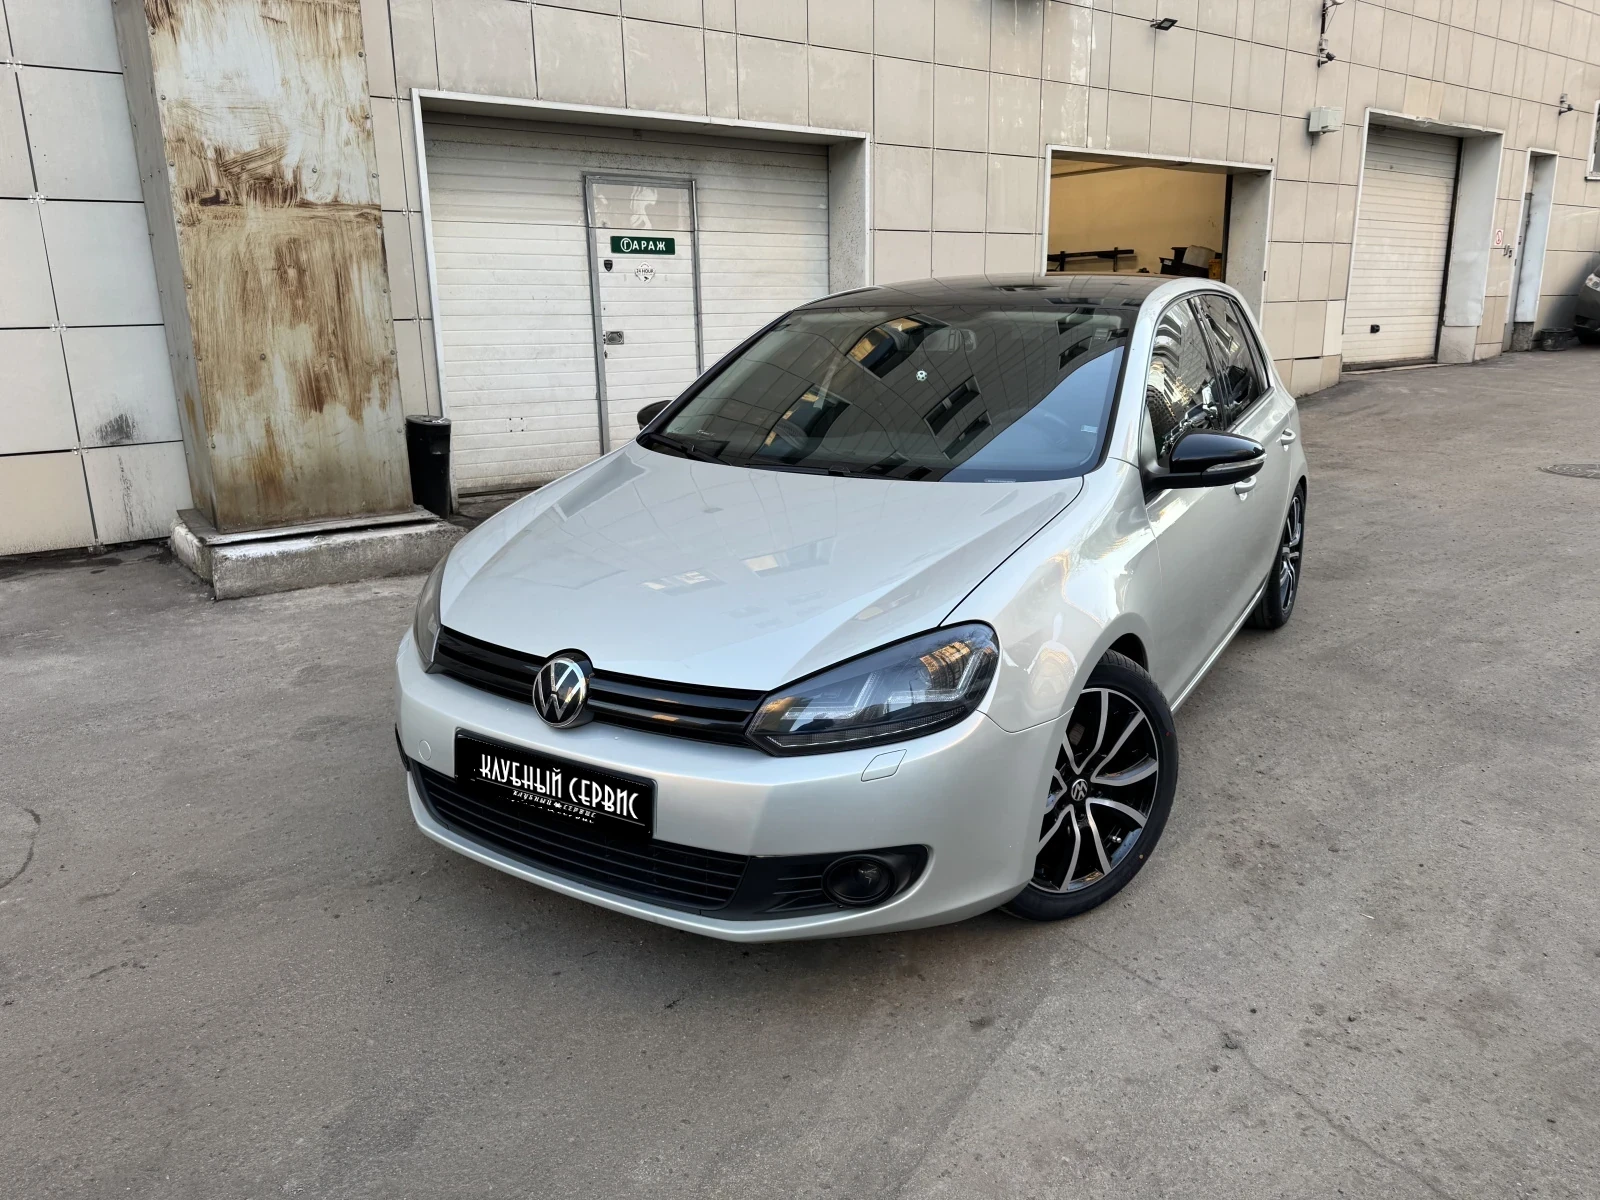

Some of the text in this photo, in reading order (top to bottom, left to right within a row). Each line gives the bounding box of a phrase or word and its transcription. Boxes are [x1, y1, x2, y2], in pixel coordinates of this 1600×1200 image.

[620, 237, 666, 252] ГАРАЖ
[479, 753, 562, 798] КЛУБНЫЙ
[568, 777, 639, 819] СЕРВИС
